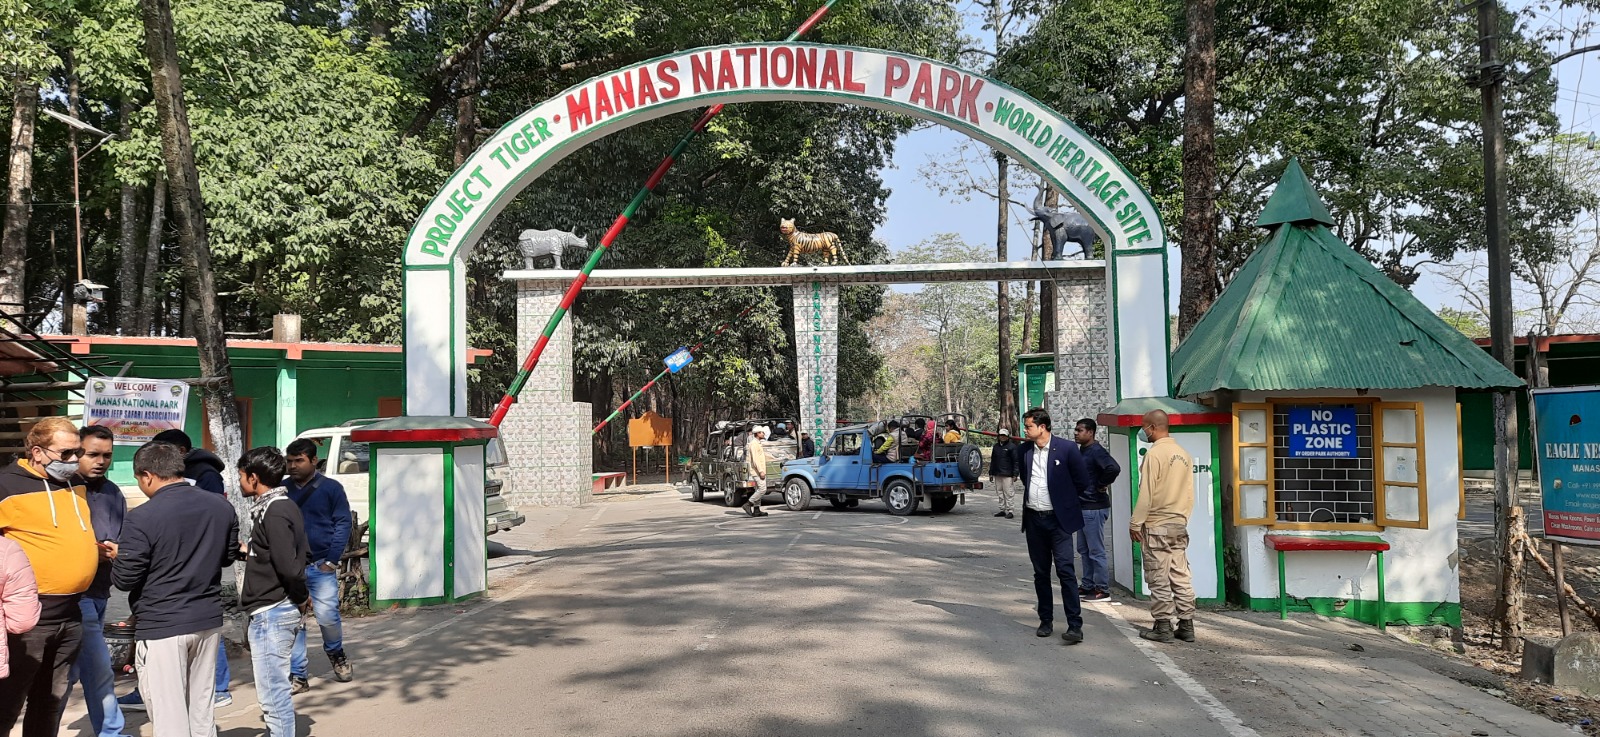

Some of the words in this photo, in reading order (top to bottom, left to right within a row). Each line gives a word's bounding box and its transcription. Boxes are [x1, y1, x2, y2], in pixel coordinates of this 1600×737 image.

[565, 59, 681, 132] MANAS
[690, 46, 866, 94] NATIONAL
[884, 56, 985, 126] PARK
[993, 96, 1053, 148] WORLD
[1050, 134, 1123, 211] HERITAGE
[1114, 194, 1153, 247] SITE
[420, 165, 493, 258] PROJECT
[489, 116, 553, 170] TIGER
[812, 281, 822, 332] MANAS
[813, 335, 823, 415] NATIONAL
[114, 382, 157, 392] WELCOME
[95, 397, 121, 407] MANAS
[121, 398, 159, 408] NATIONAL
[160, 399, 179, 410] PARK
[90, 408, 110, 418] MANAS
[111, 409, 123, 418] JEEP
[124, 409, 143, 419] SAFARI
[144, 411, 180, 421] ASSOCIATION
[1311, 410, 1333, 422] NO
[1293, 423, 1352, 435] PLASTIC
[1305, 437, 1343, 449] ZONE
[1545, 442, 1580, 459] EAGLE
[1572, 464, 1600, 473] MANAS
